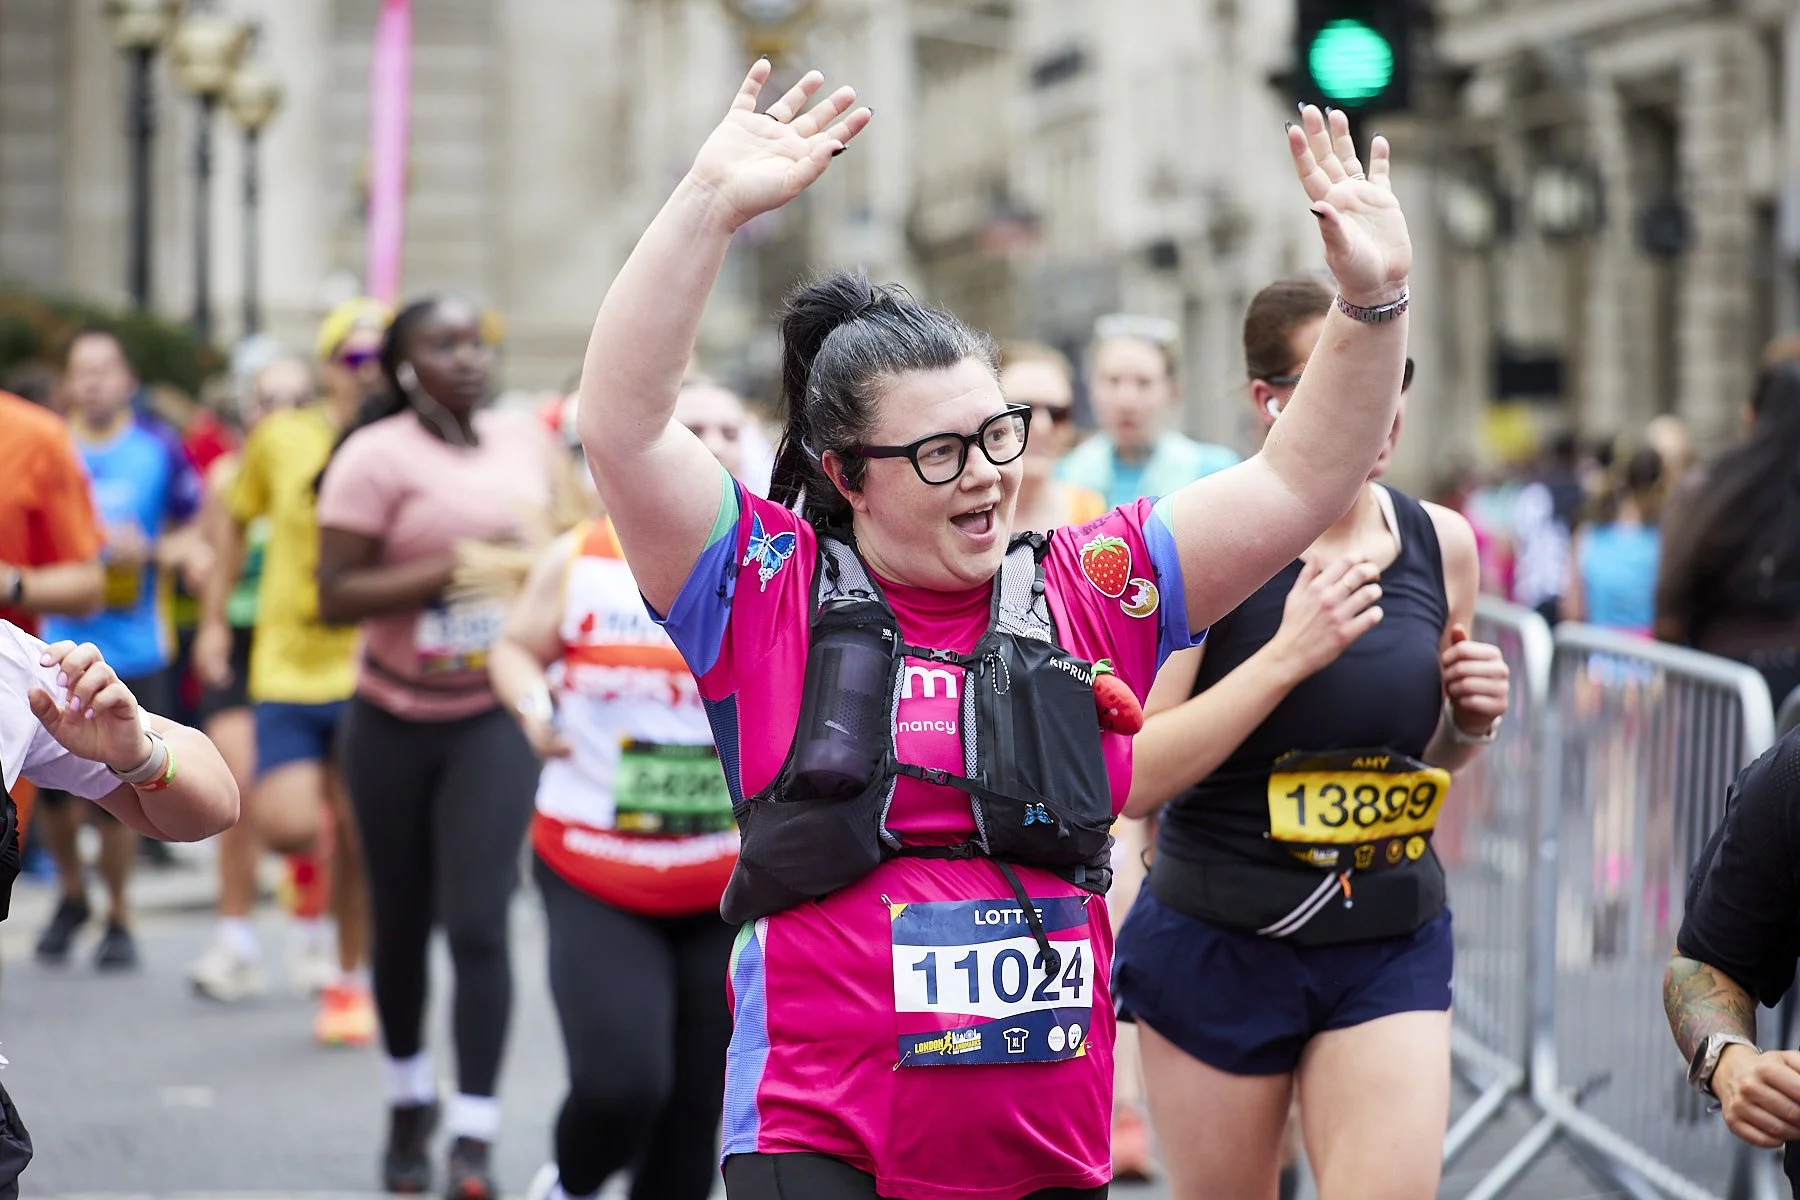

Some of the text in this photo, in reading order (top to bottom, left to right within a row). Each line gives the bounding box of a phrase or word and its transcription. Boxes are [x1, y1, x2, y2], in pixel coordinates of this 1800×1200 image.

[1050, 656, 1093, 687] KIPRUN
[895, 720, 957, 735] nancy
[1352, 755, 1391, 770] AMY
[1286, 781, 1438, 828] 13899
[974, 908, 1043, 926] LOTTE
[912, 946, 1084, 1005] 11024
[914, 1037, 944, 1054] LONDON
[1012, 1037, 1021, 1048] XL
